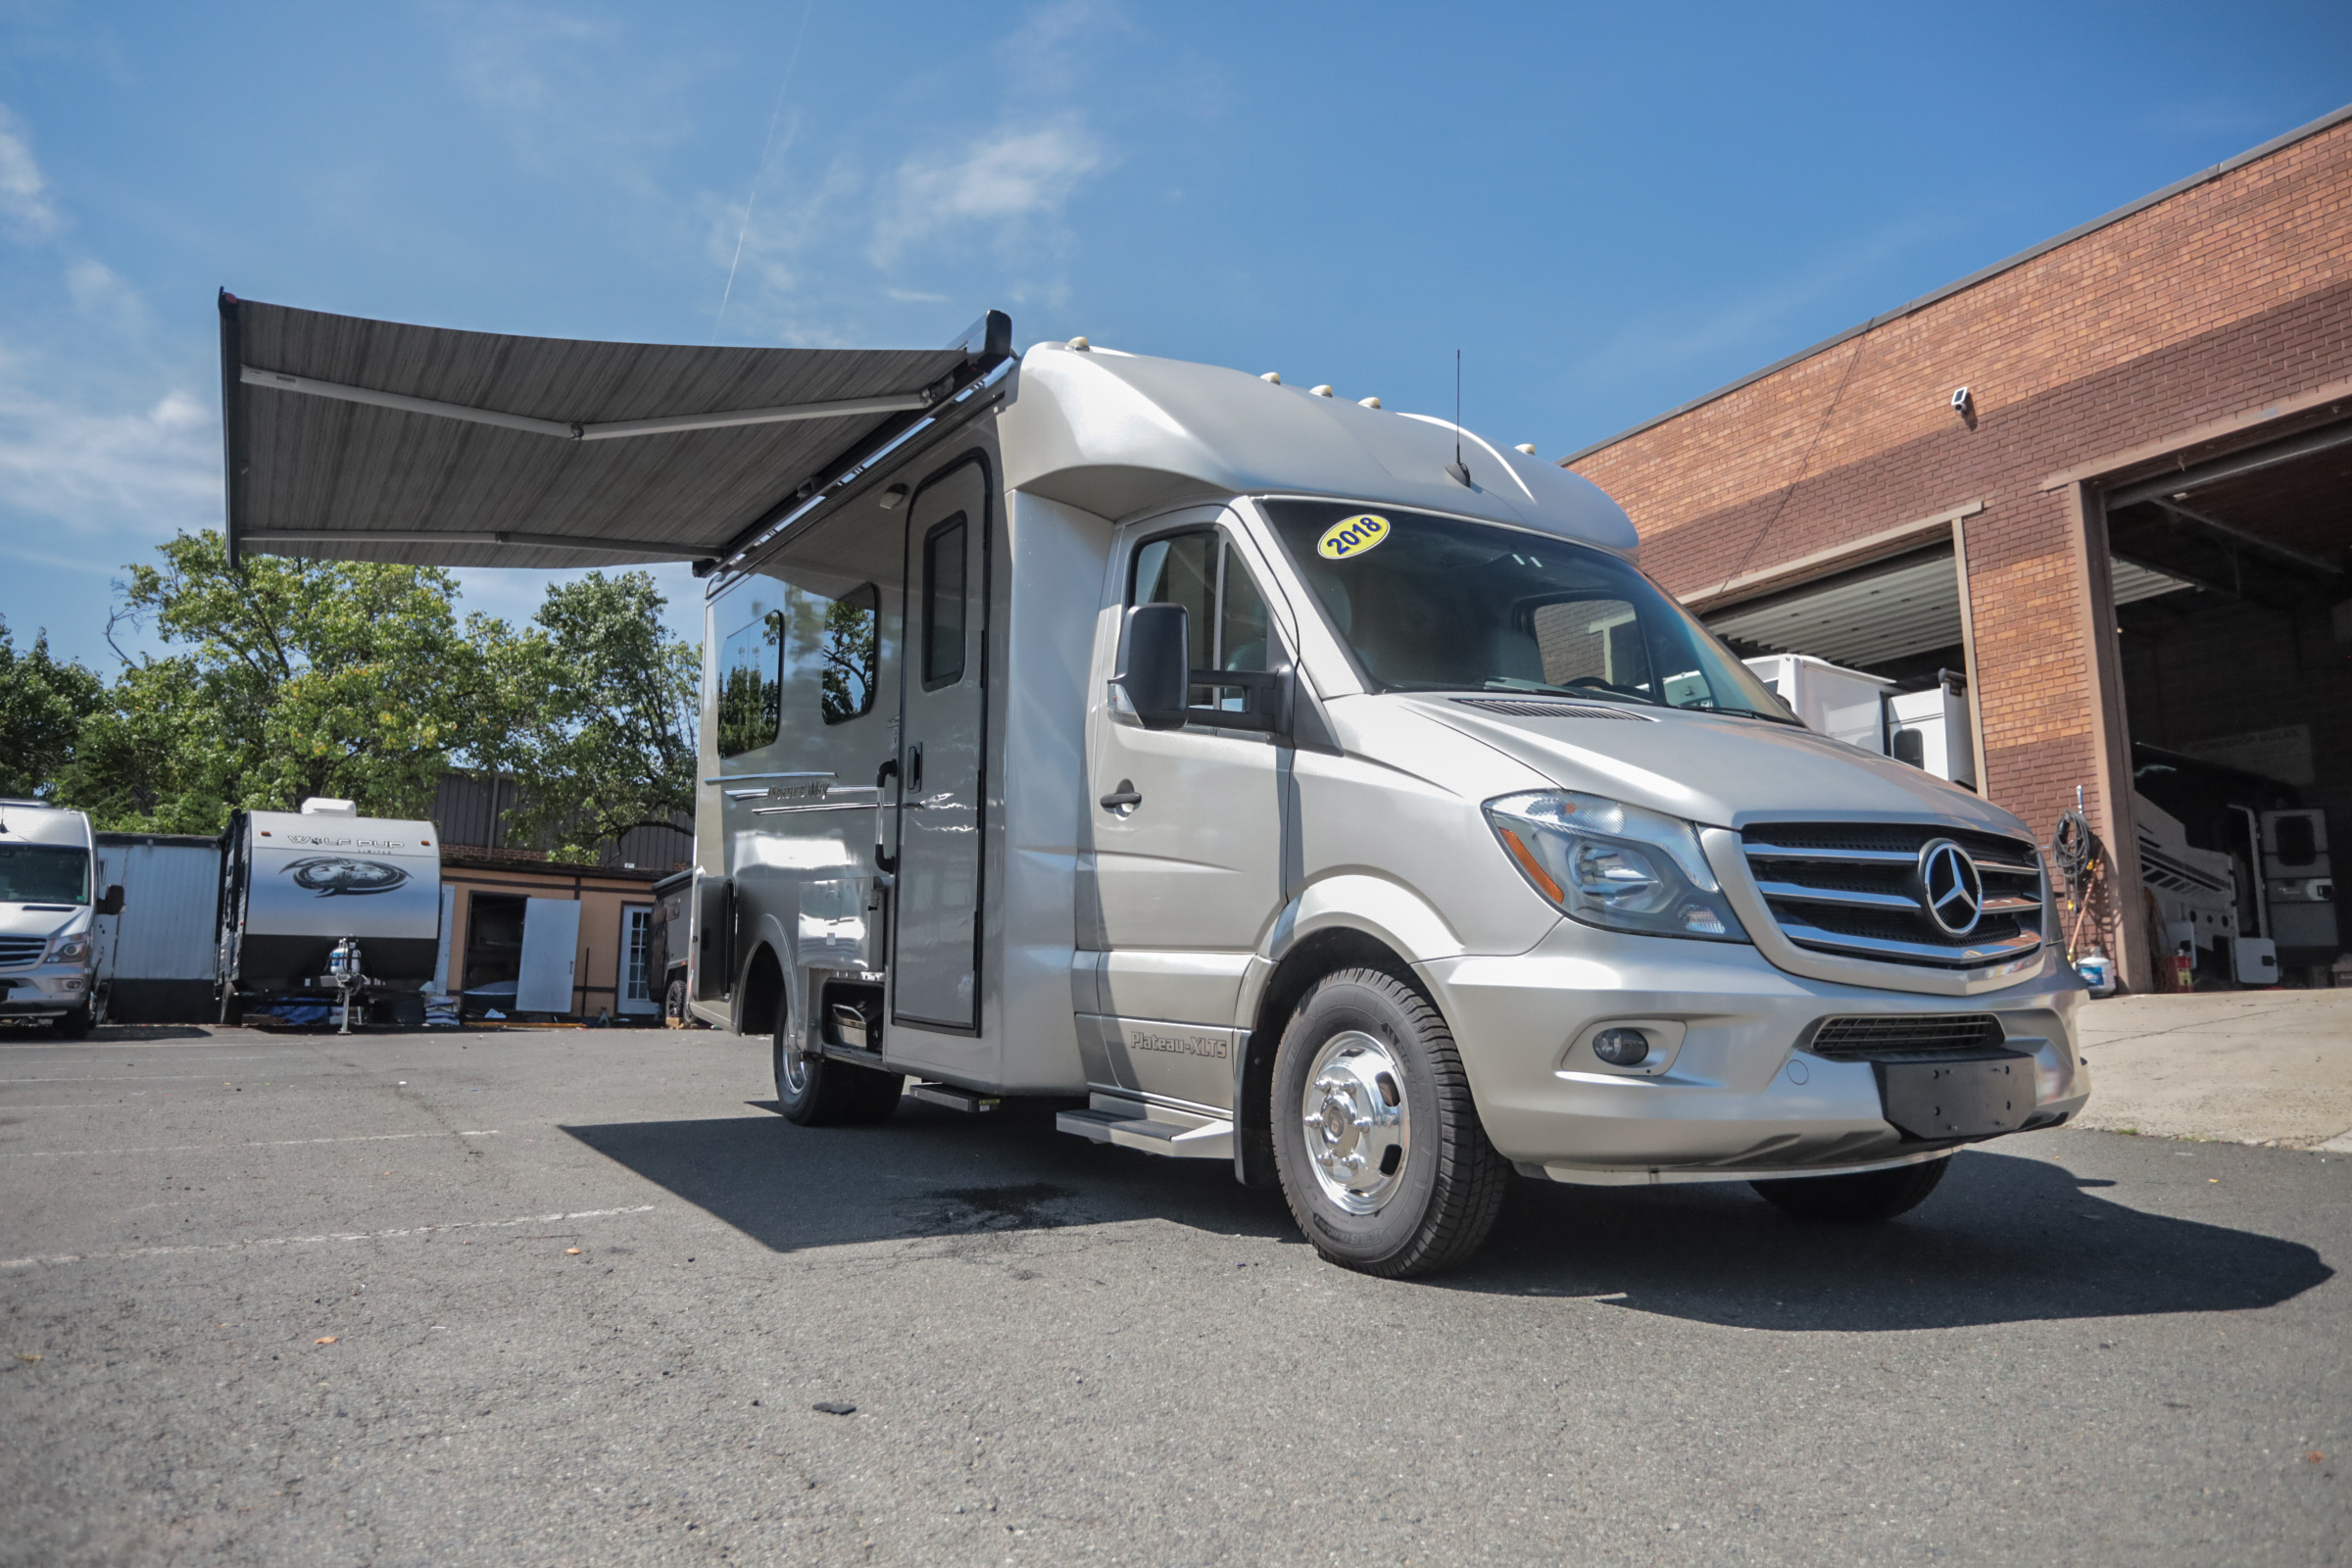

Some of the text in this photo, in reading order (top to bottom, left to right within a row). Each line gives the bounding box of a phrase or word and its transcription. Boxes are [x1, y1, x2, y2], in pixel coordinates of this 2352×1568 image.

[1327, 516, 1382, 556] 2018
[287, 835, 405, 849] WLF PUP
[1131, 1031, 1228, 1058] Plateau-XLTS
